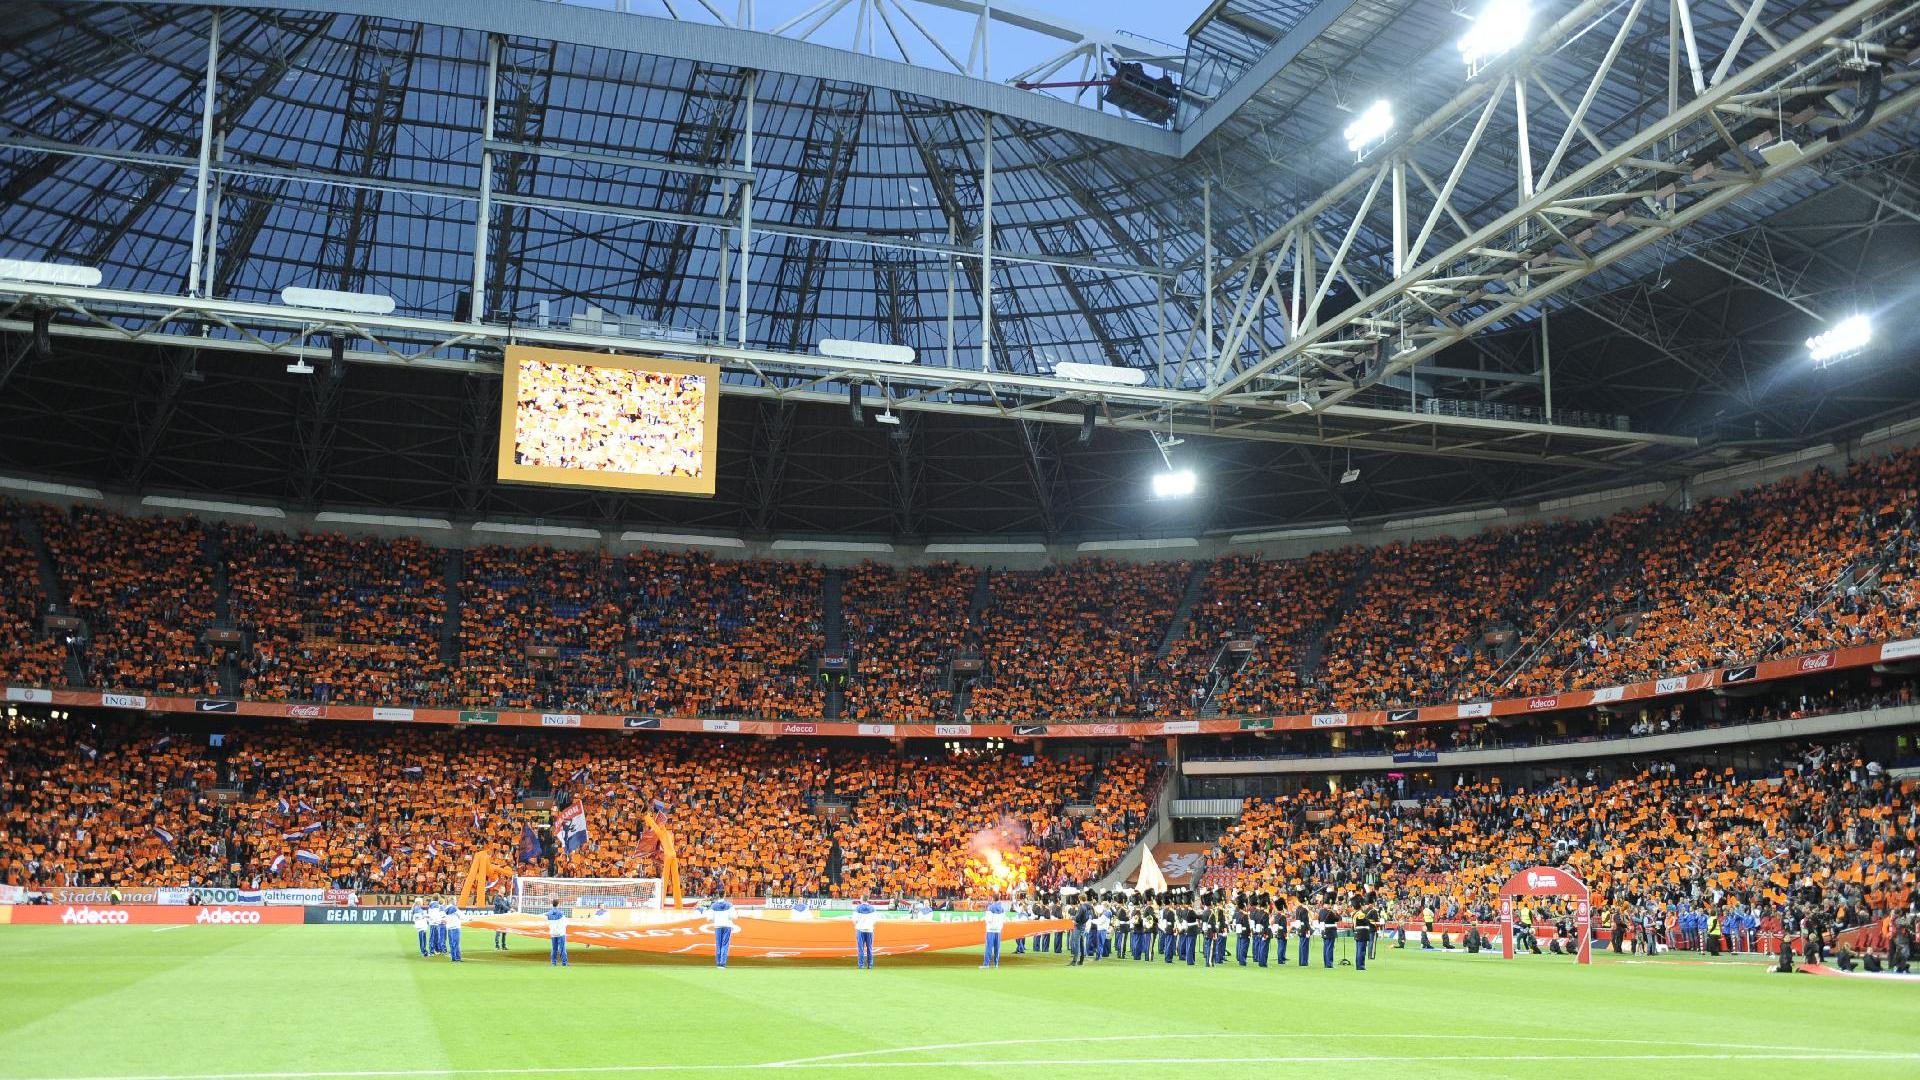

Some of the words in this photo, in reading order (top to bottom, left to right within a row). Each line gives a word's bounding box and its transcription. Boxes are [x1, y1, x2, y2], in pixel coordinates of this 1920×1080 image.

[1657, 681, 1673, 691] ING
[105, 696, 127, 706] ING
[1530, 699, 1555, 709] Adecco
[544, 717, 564, 725] ING
[1314, 717, 1332, 725] ING
[785, 724, 814, 733] Adecco
[59, 890, 157, 903] Stadsknaal
[62, 906, 129, 924] Adecco
[196, 907, 261, 924] Adecco
[327, 910, 358, 922] GEAR
[362, 910, 378, 922] UP
[382, 910, 397, 922] AT
